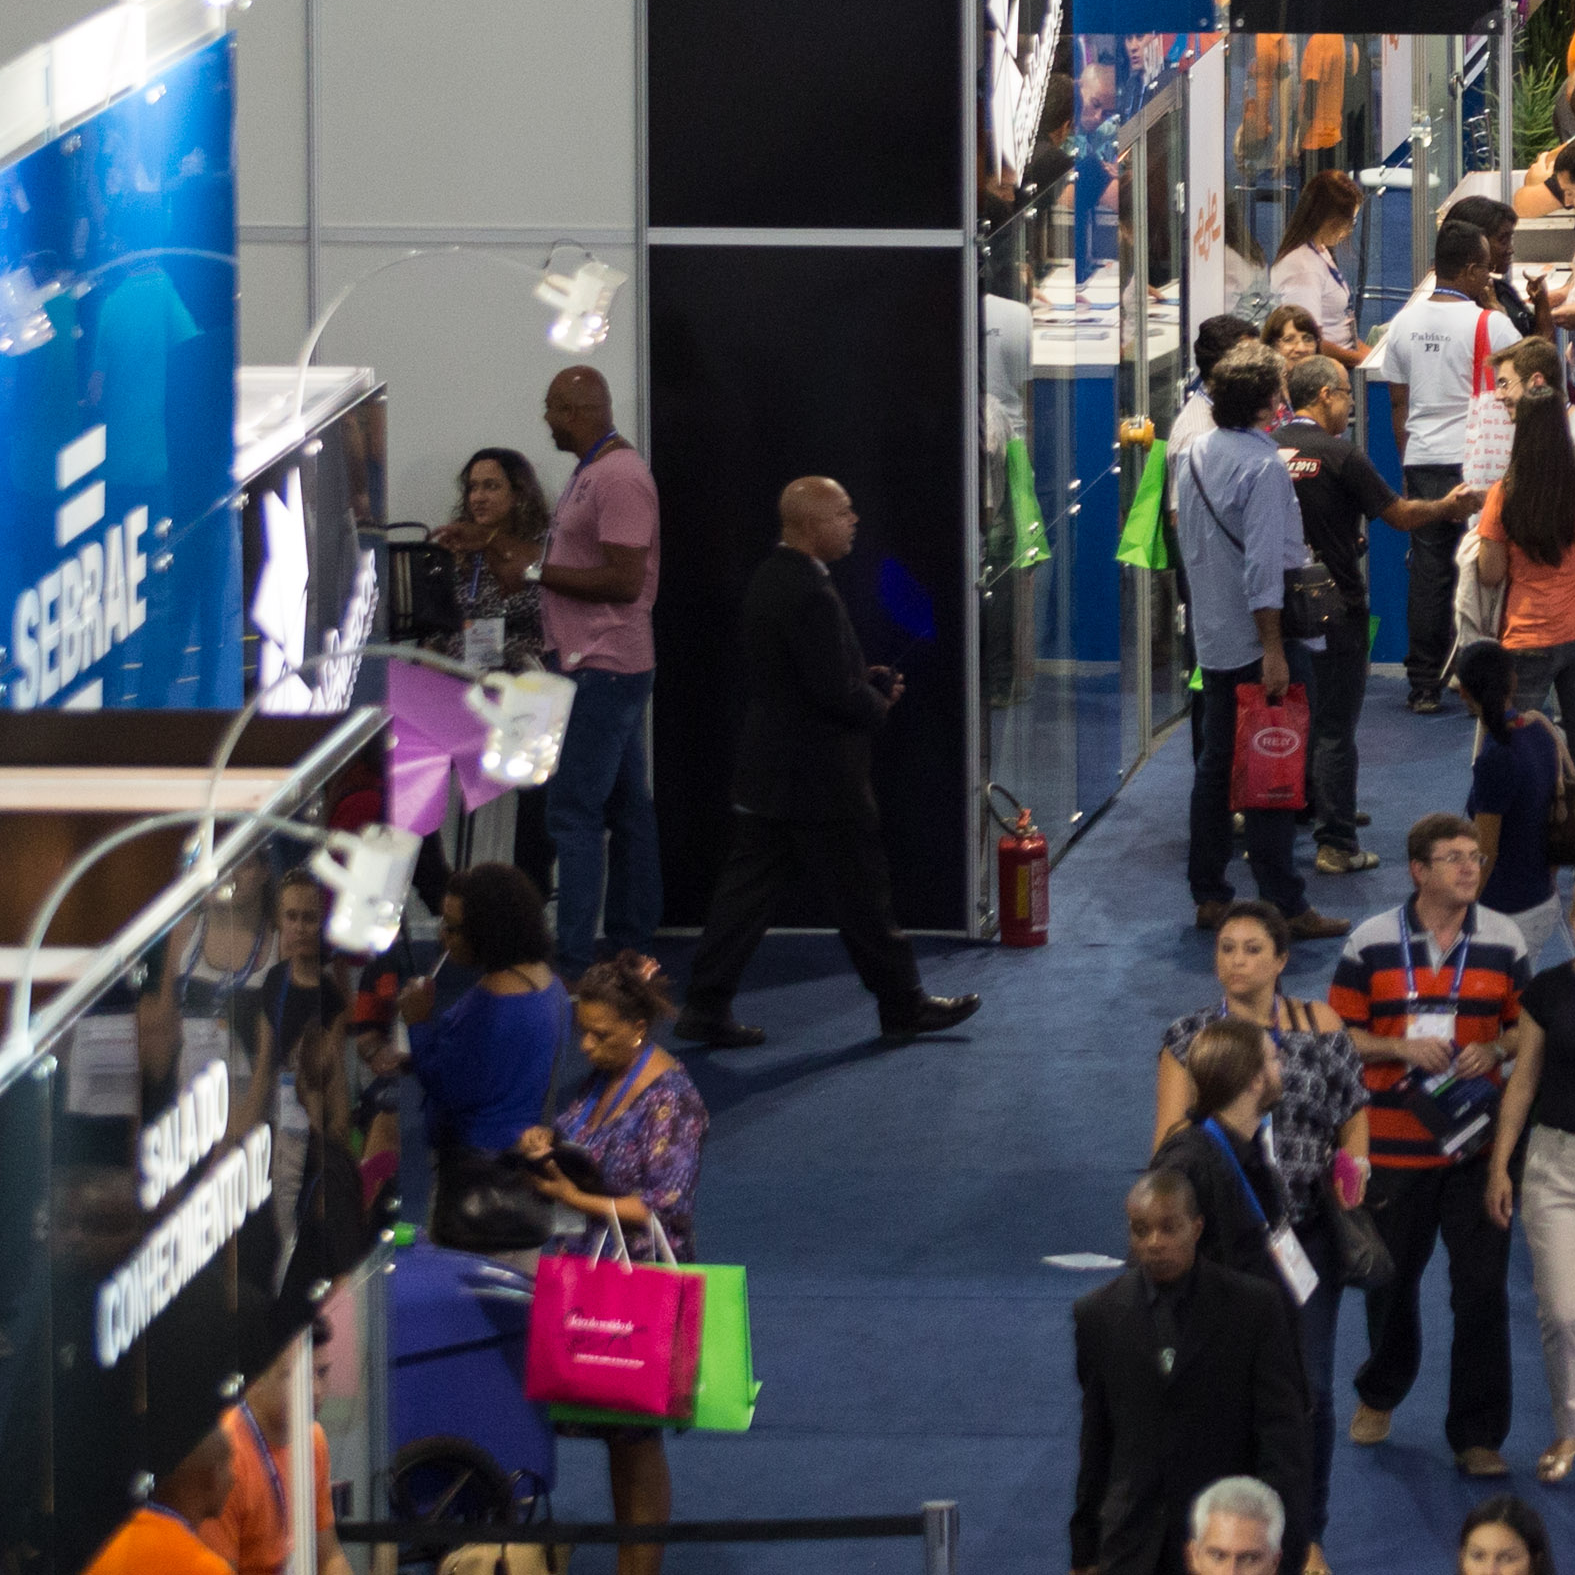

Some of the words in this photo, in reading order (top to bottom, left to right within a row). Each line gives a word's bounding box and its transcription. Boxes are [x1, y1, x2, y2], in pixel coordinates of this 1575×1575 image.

[12, 505, 149, 710] SEBRAE
[140, 1091, 200, 1211] SALA
[194, 1059, 229, 1158] DO
[97, 1149, 248, 1368] CONHECIMENTO
[246, 1124, 273, 1212] 02
